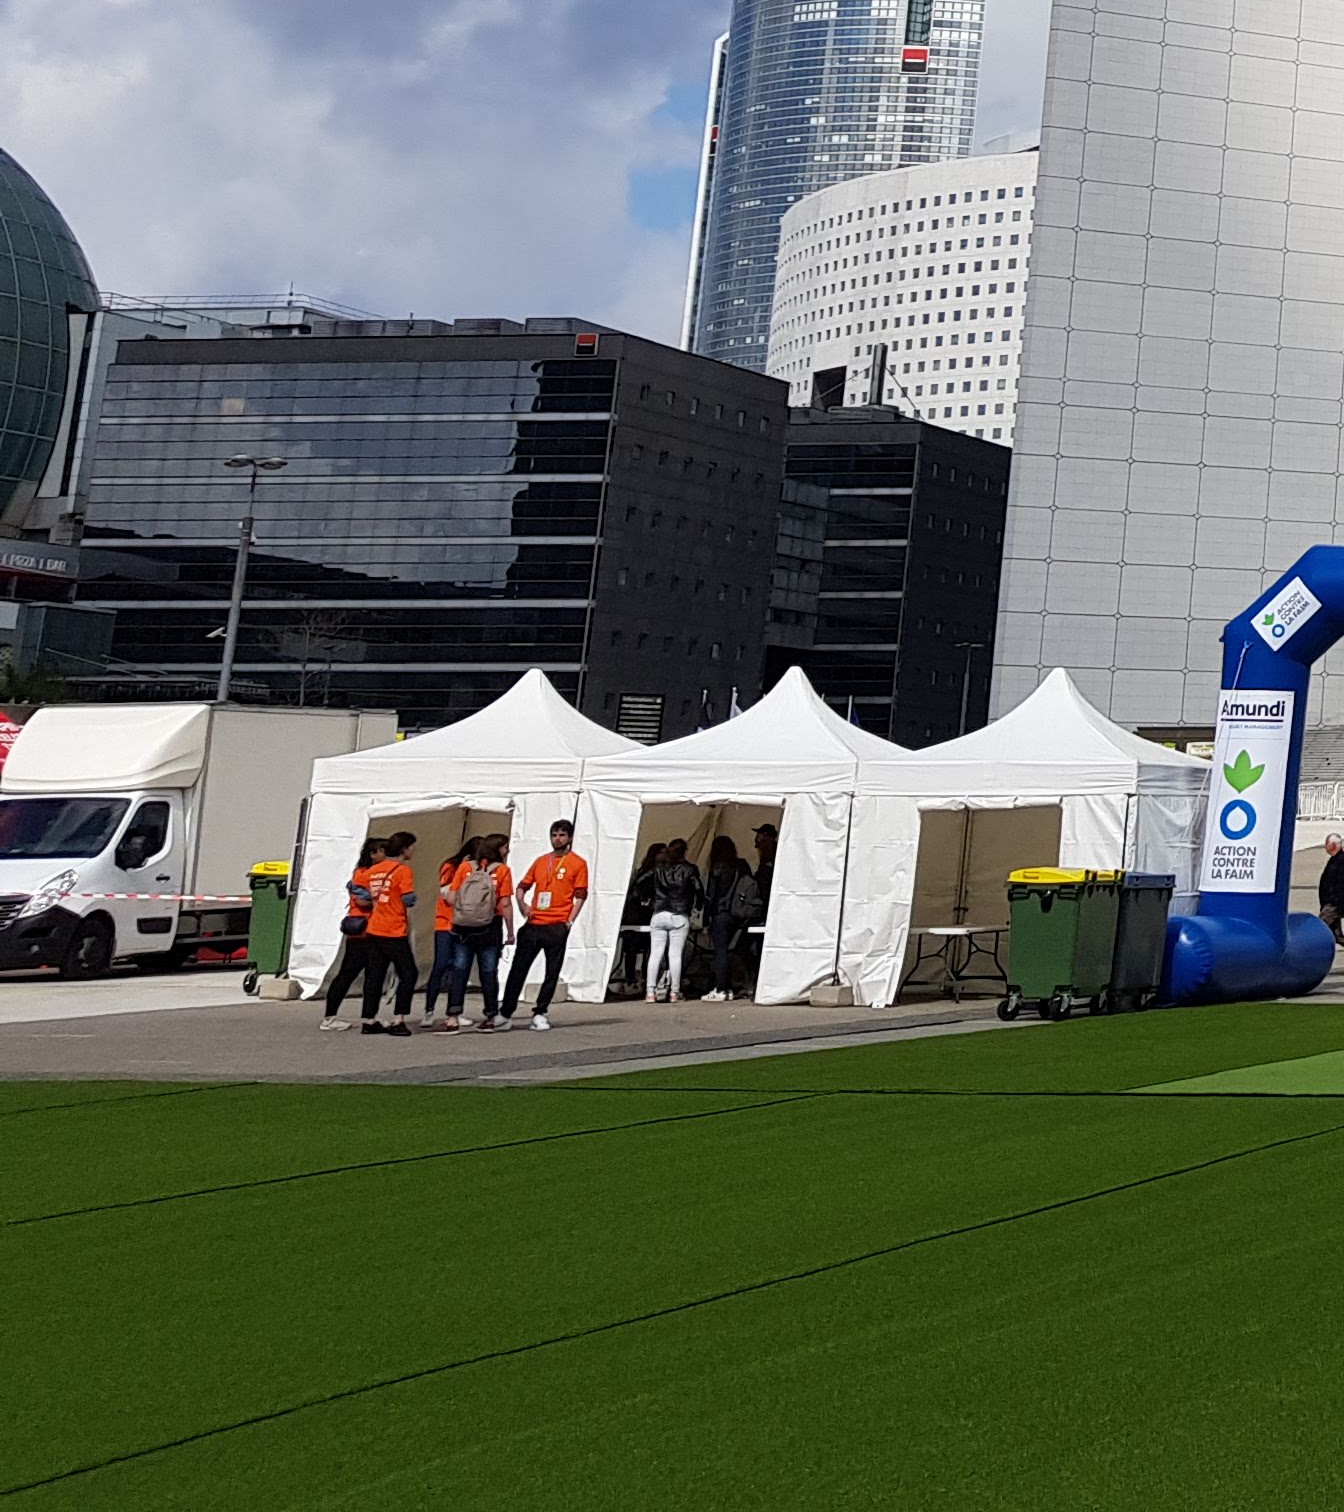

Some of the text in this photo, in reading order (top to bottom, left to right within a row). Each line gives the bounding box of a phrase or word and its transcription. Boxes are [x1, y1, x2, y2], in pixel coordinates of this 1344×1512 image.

[1277, 590, 1301, 615] ACTION
[1280, 594, 1305, 620] CONTRE
[1292, 600, 1311, 618] FAIM
[1221, 699, 1286, 716] Amundi
[1213, 846, 1257, 856] ACTION
[1212, 857, 1256, 868] CONTRE
[1211, 868, 1254, 880] LA FAIM
